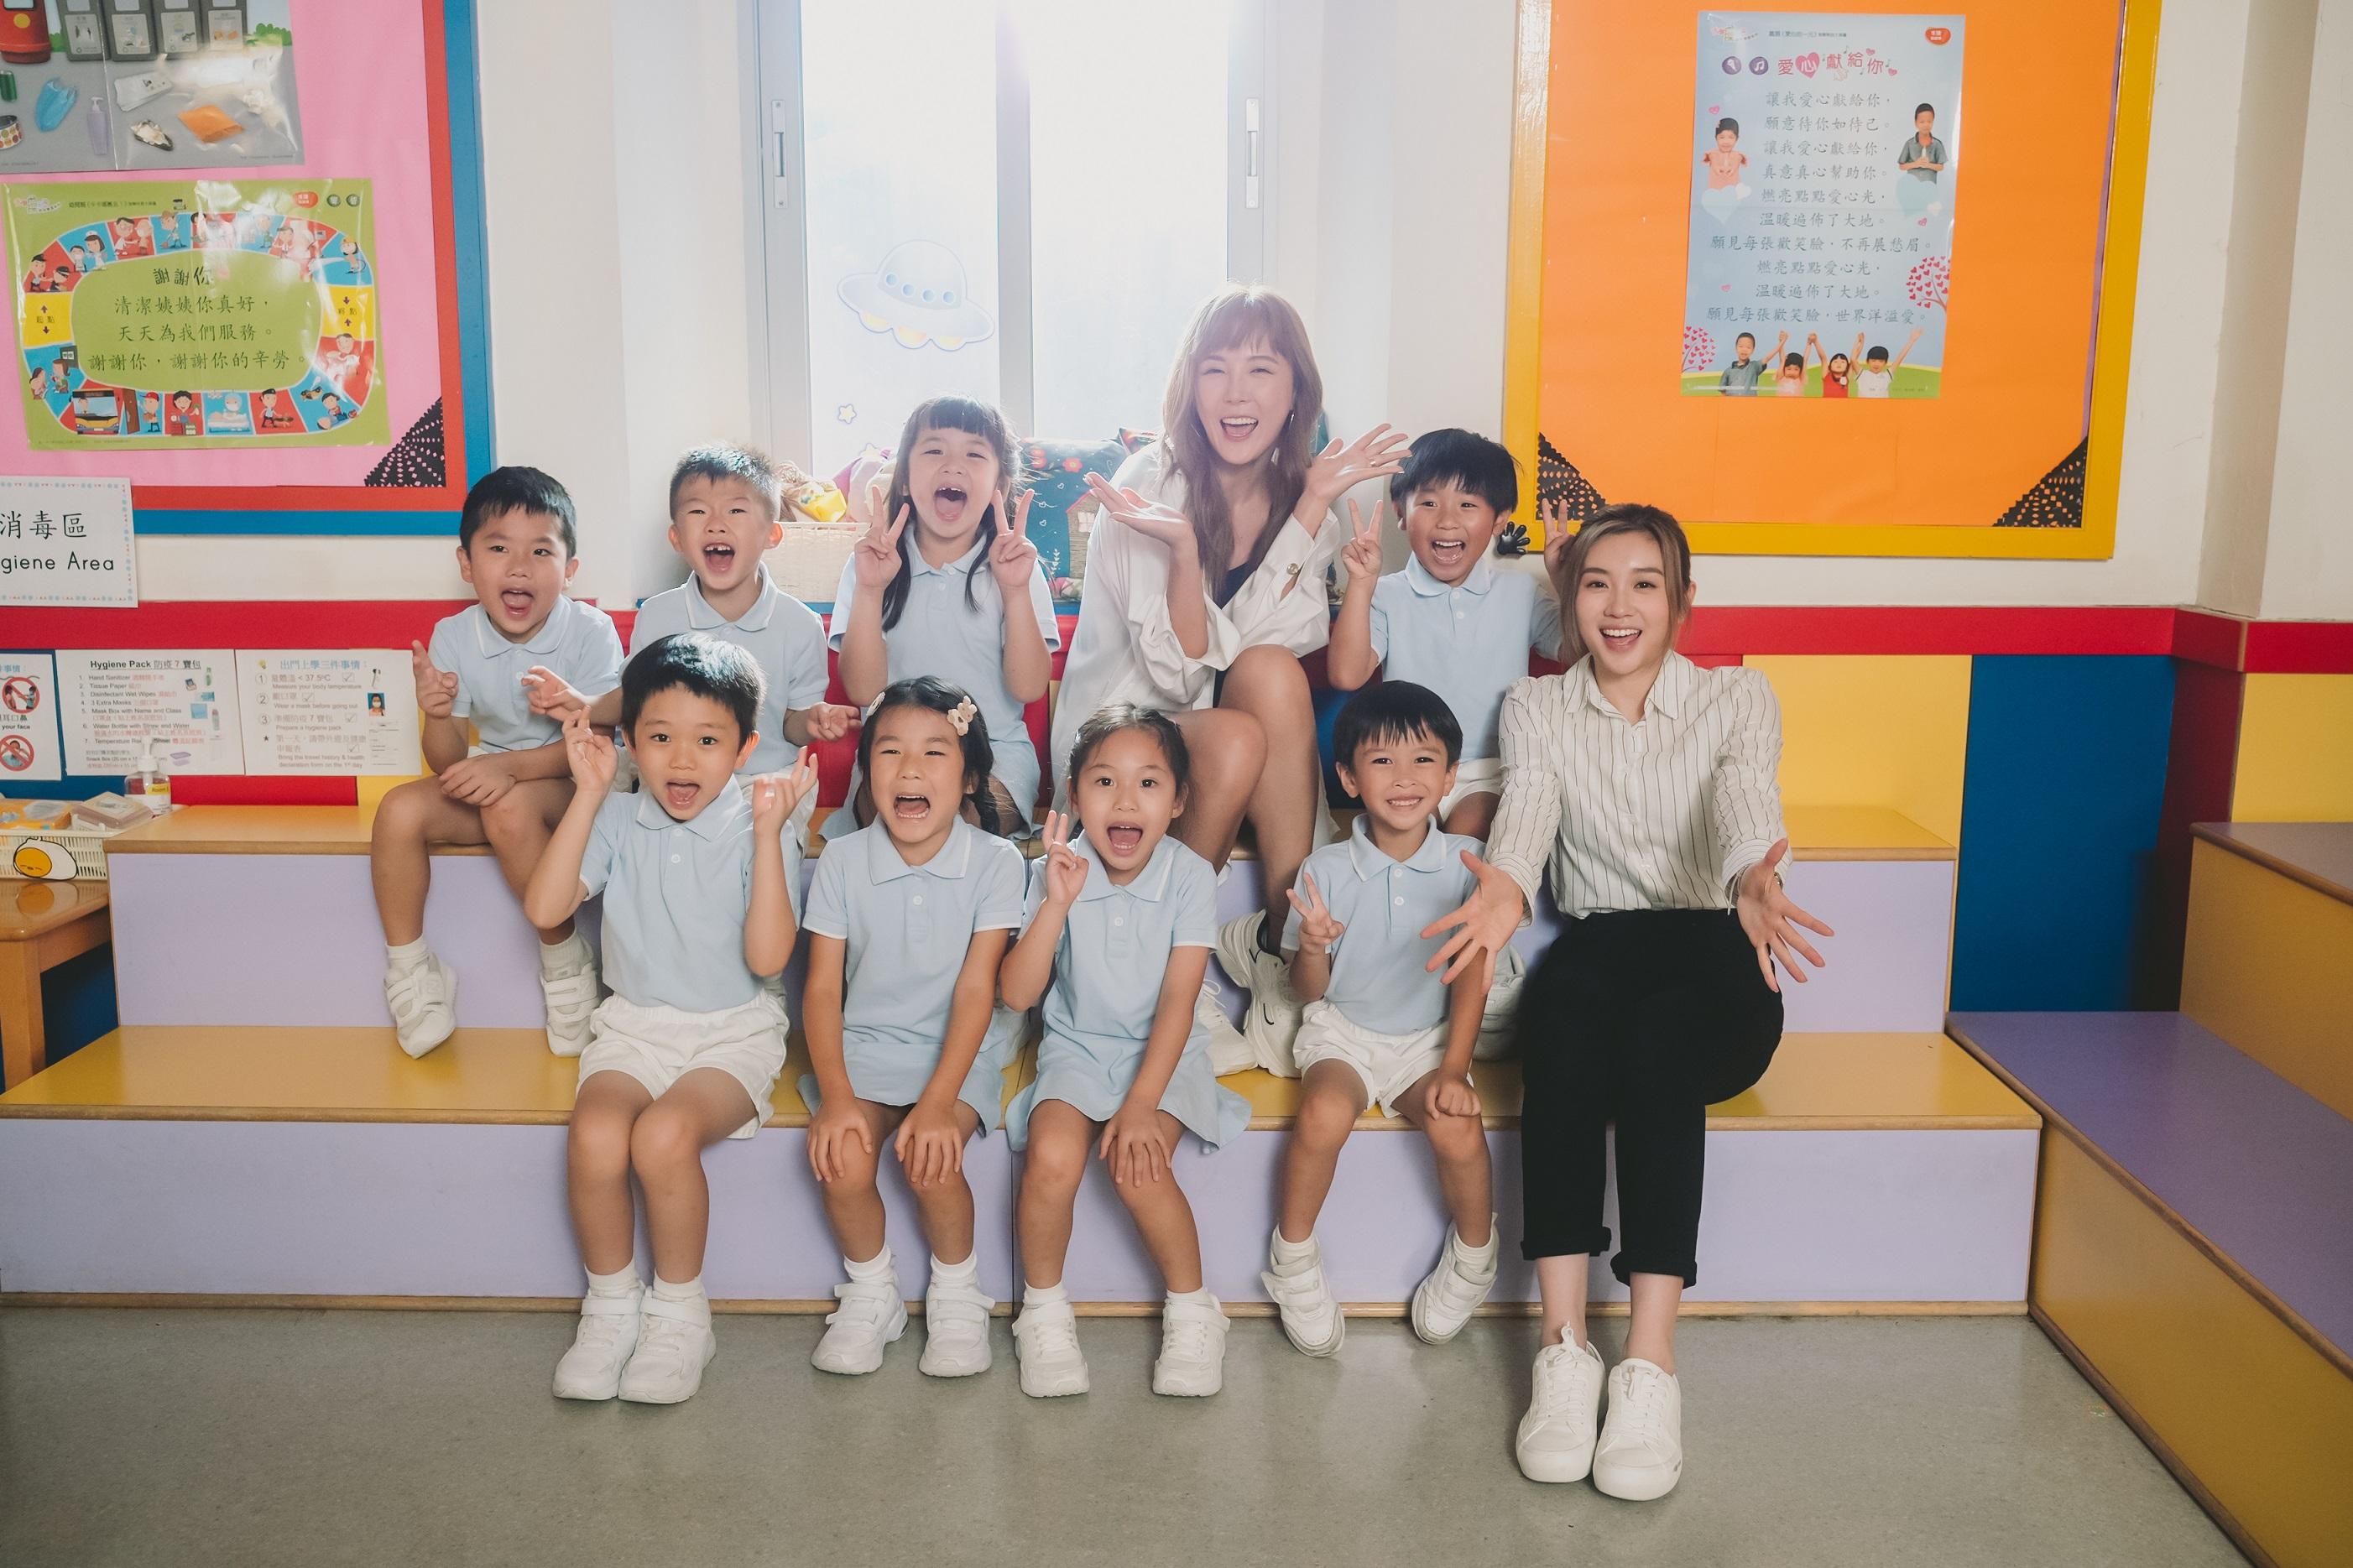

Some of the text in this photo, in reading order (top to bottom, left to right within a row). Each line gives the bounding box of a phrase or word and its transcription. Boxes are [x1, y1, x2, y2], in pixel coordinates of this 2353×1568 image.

[1778, 52, 1883, 76] 愛心獻給你
[0, 510, 86, 539] 消毒區
[1, 551, 114, 574] giene Area
[91, 660, 127, 670] Hygiene
[129, 660, 151, 669] Pack
